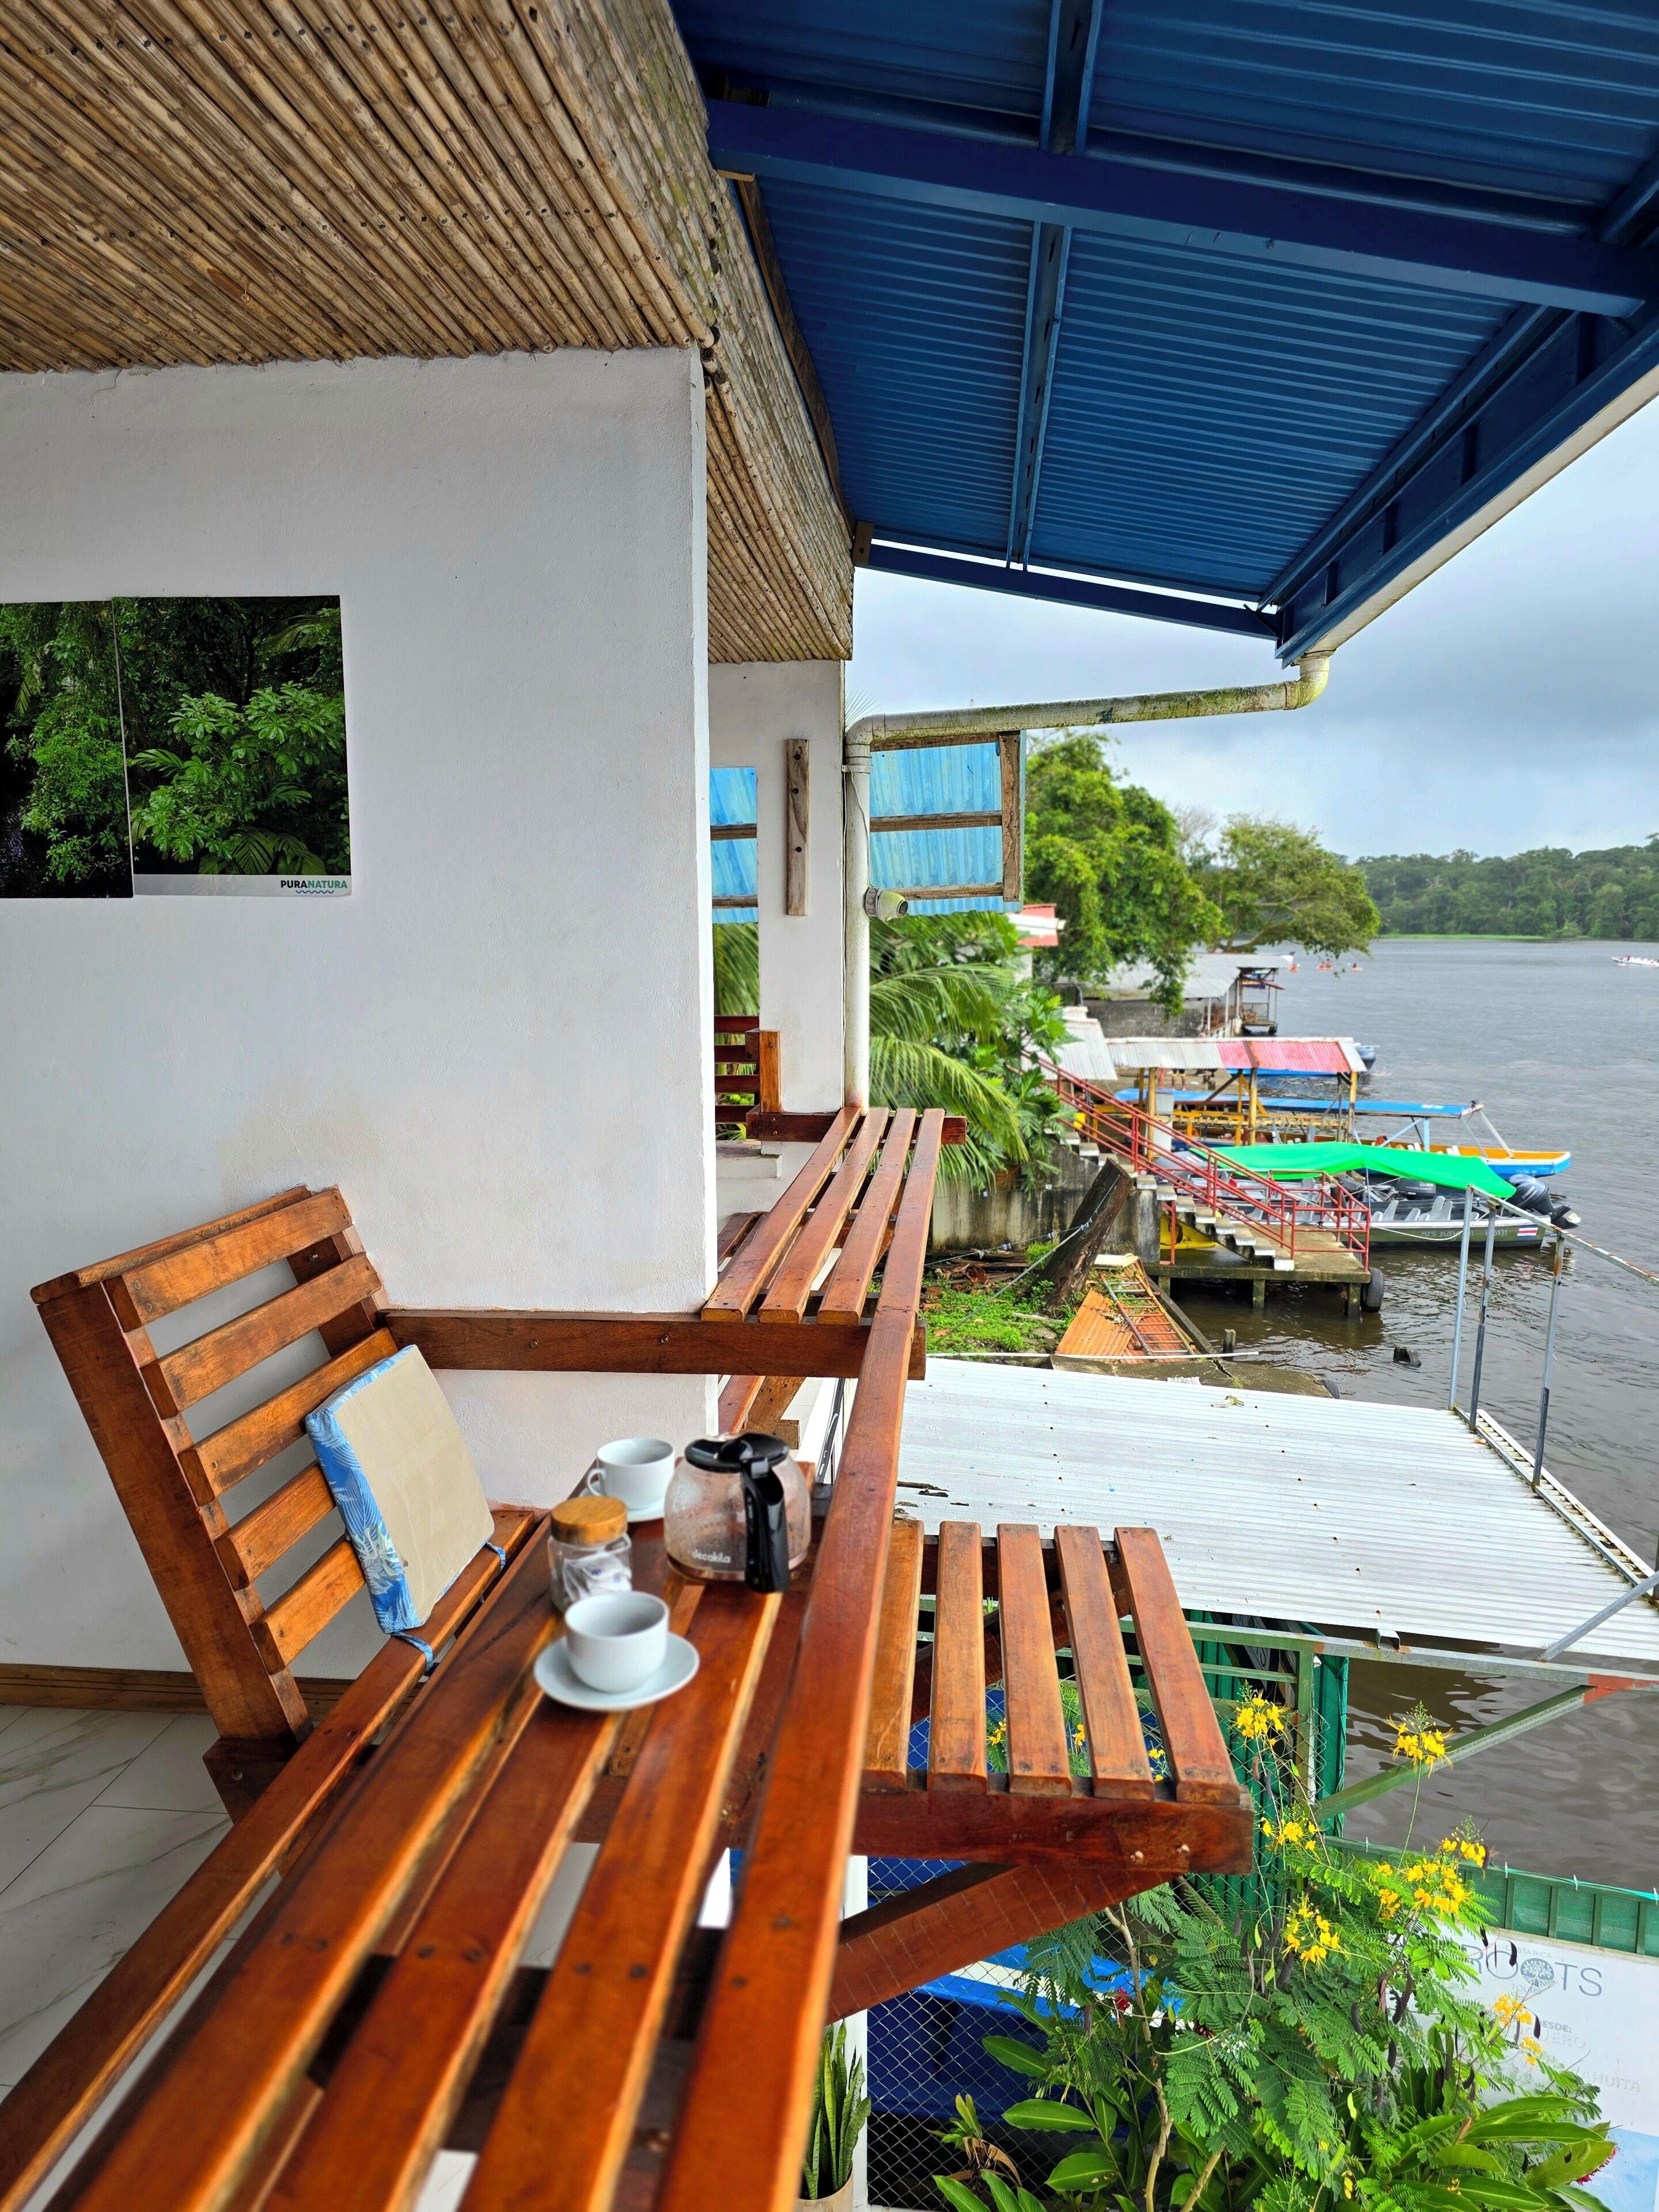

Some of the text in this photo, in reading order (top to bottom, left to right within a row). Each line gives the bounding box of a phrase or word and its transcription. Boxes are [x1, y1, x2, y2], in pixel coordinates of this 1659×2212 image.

[281, 880, 347, 888] PURANATURA
[1505, 1945, 1552, 1959] CSTA RICA
[1573, 2069, 1641, 2092] AHUITA
